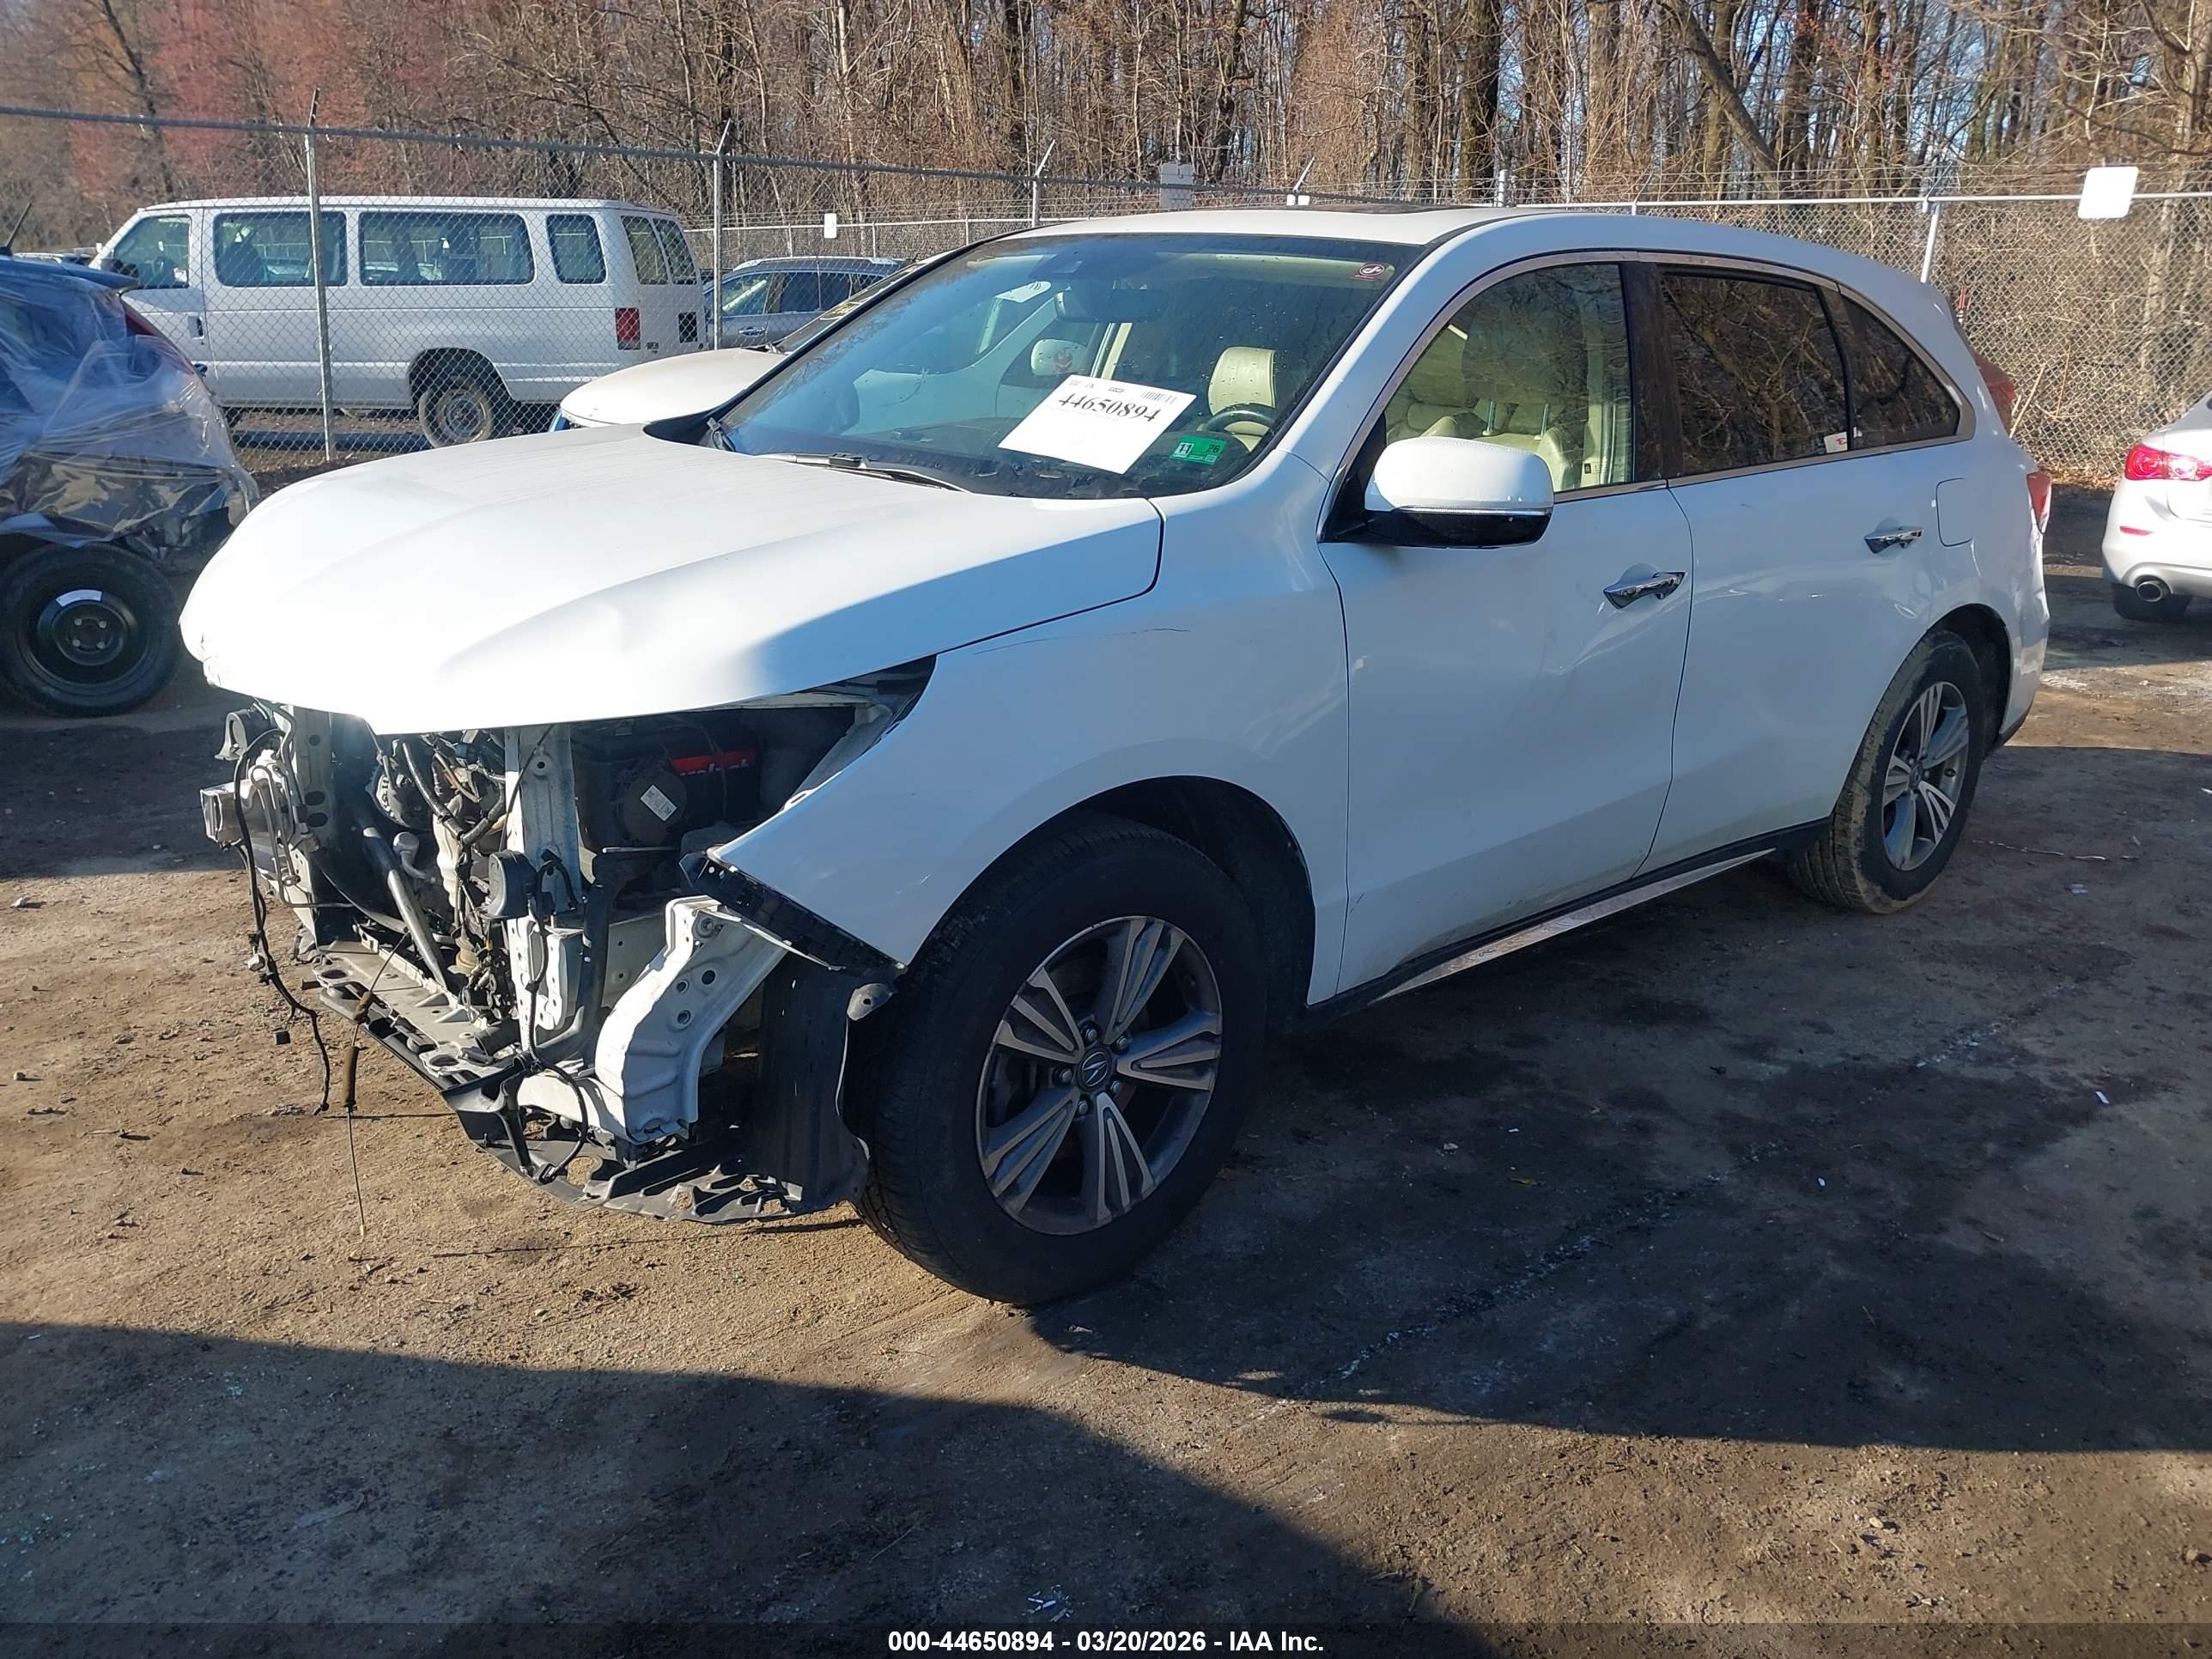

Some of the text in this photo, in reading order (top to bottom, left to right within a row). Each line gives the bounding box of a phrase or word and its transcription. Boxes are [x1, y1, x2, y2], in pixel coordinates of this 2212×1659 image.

[1059, 393, 1162, 422] 44650894
[1179, 443, 1221, 454] 11 26
